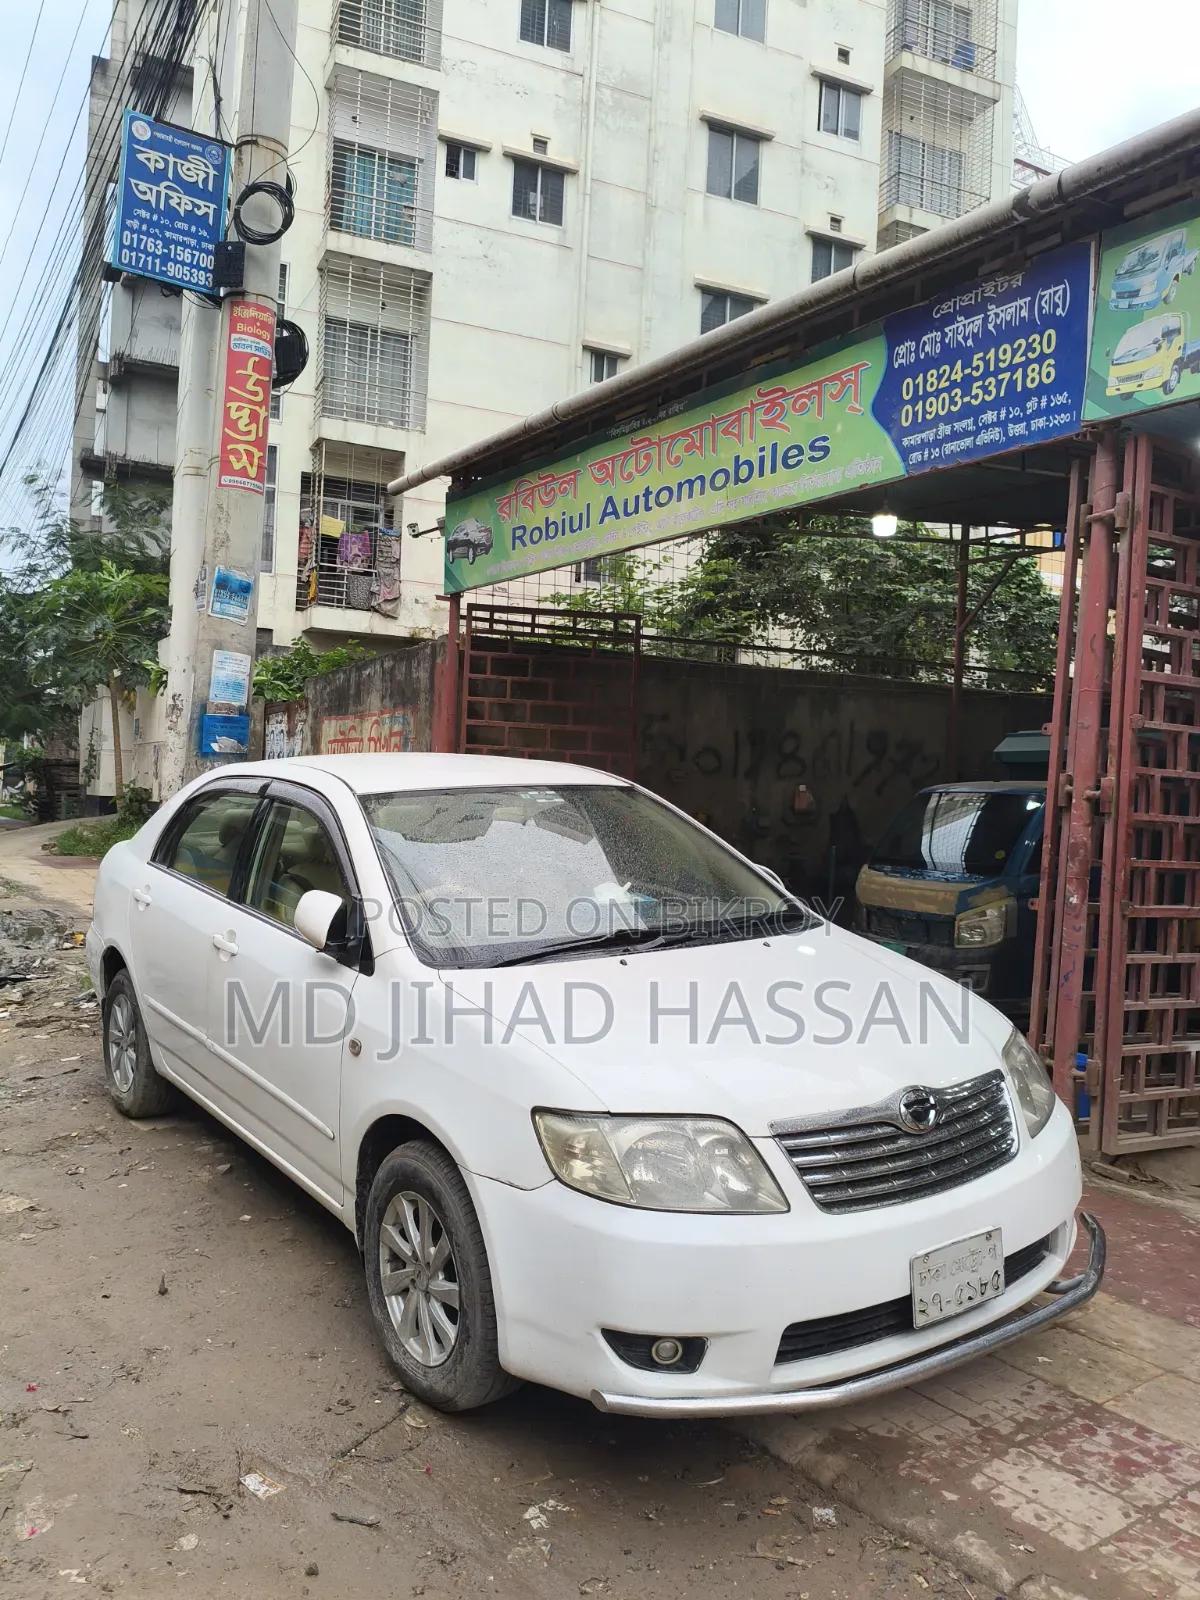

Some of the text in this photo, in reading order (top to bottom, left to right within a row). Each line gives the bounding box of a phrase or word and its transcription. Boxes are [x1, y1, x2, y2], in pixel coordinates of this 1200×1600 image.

[132, 144, 219, 192] কাজী
[128, 177, 218, 226] অফিস
[174, 220, 189, 231] রোড
[121, 249, 213, 287] 01711-905393
[122, 230, 215, 270] 01763-156700
[236, 322, 271, 341] Biology
[944, 311, 983, 348] সাইদুল
[987, 296, 1031, 338] ইসলাম
[902, 328, 1057, 401] 01824-519230
[901, 359, 1056, 428] 01903-537186
[495, 360, 872, 523] রবিউল অটোমোবাইলস্
[511, 434, 831, 551] Robiul Automobiles
